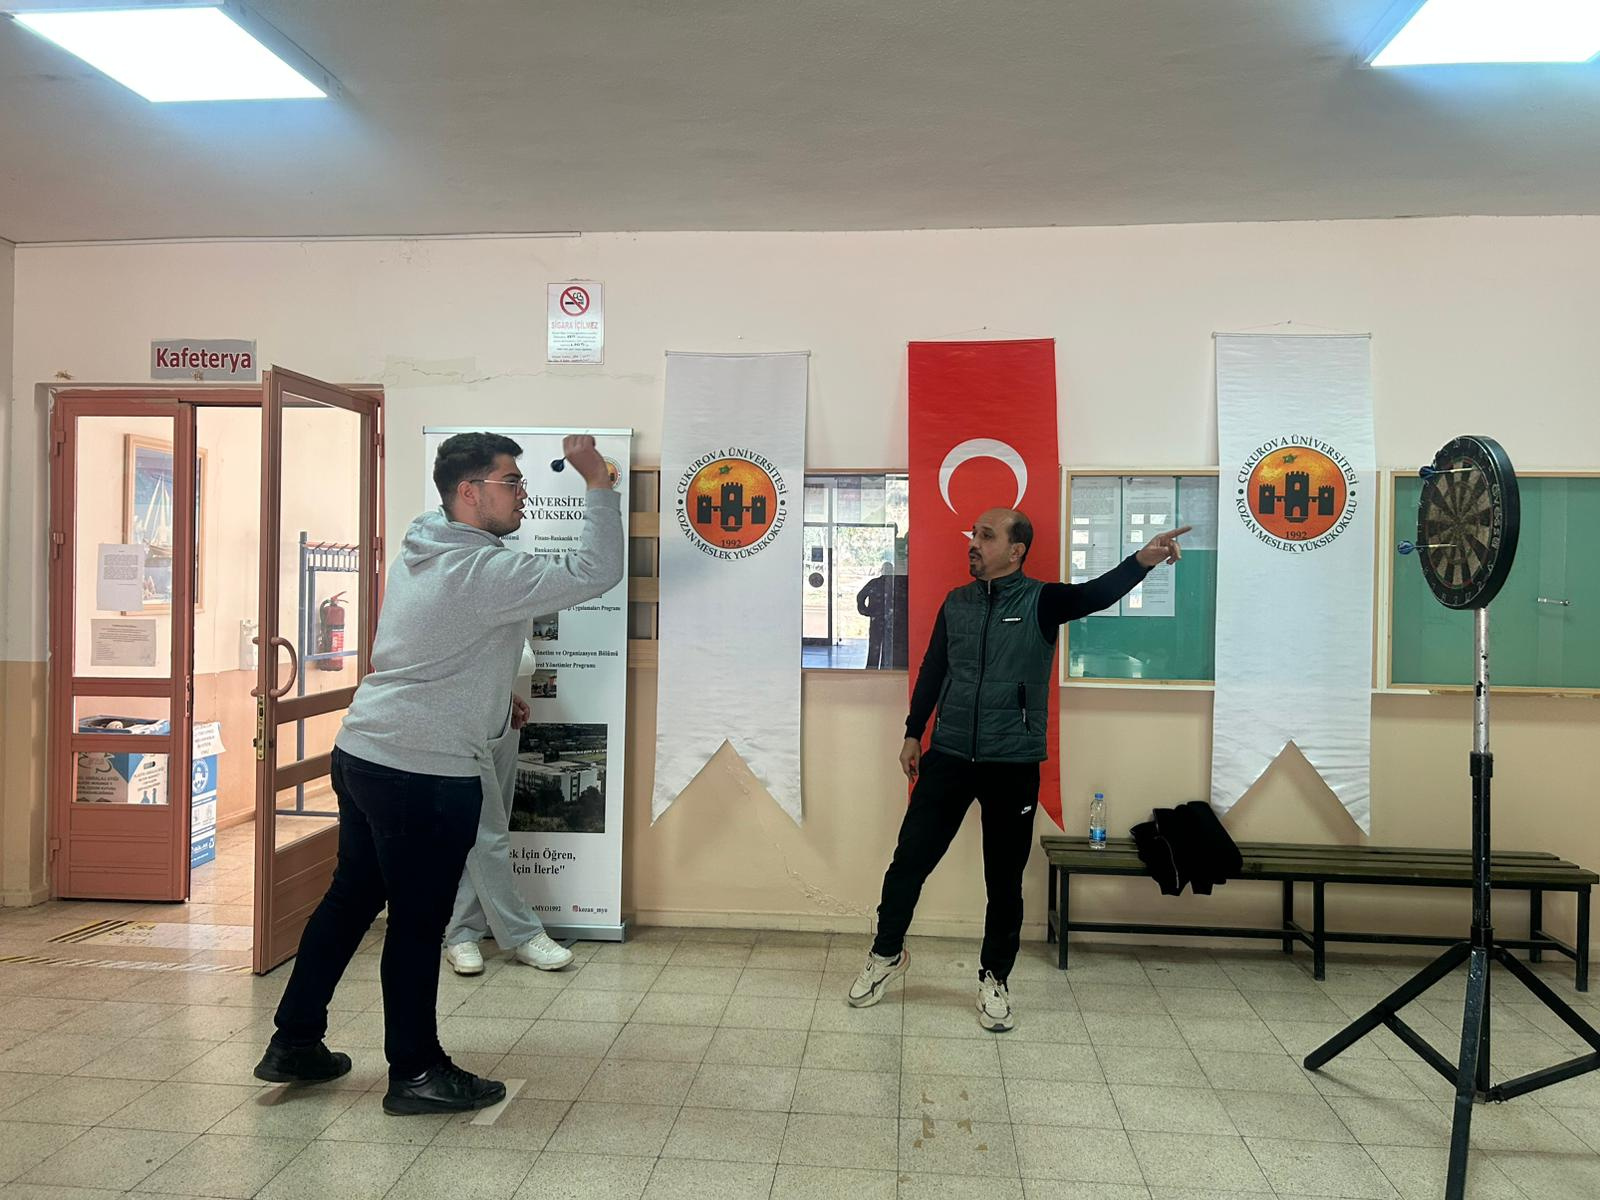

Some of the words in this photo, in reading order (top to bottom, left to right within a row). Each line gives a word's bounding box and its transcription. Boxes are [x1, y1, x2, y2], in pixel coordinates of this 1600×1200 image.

[156, 347, 251, 373] Kafeterya
[1238, 436, 1289, 484] ÇUKUROVA
[1291, 434, 1359, 486] ÜNİVERSİTESİ
[677, 449, 726, 494] ÇUKUROVA
[728, 447, 789, 495] ÜNİVERSİTESİ
[527, 494, 586, 507] NİVERSİTE
[530, 508, 585, 520] YÜKSEKO
[1236, 498, 1259, 534] KOZAN
[1256, 530, 1297, 552] MESLEK
[1298, 500, 1358, 552] YÜKSEKOKULU
[675, 508, 698, 543] KOZAN
[694, 539, 731, 560] MESLEK
[733, 508, 788, 560] YÜKSEKOKULU
[1285, 531, 1307, 540] 1992
[721, 539, 742, 548] 1992
[521, 847, 540, 860] İçin
[542, 847, 576, 861] Öğren,
[512, 862, 531, 875] İçin
